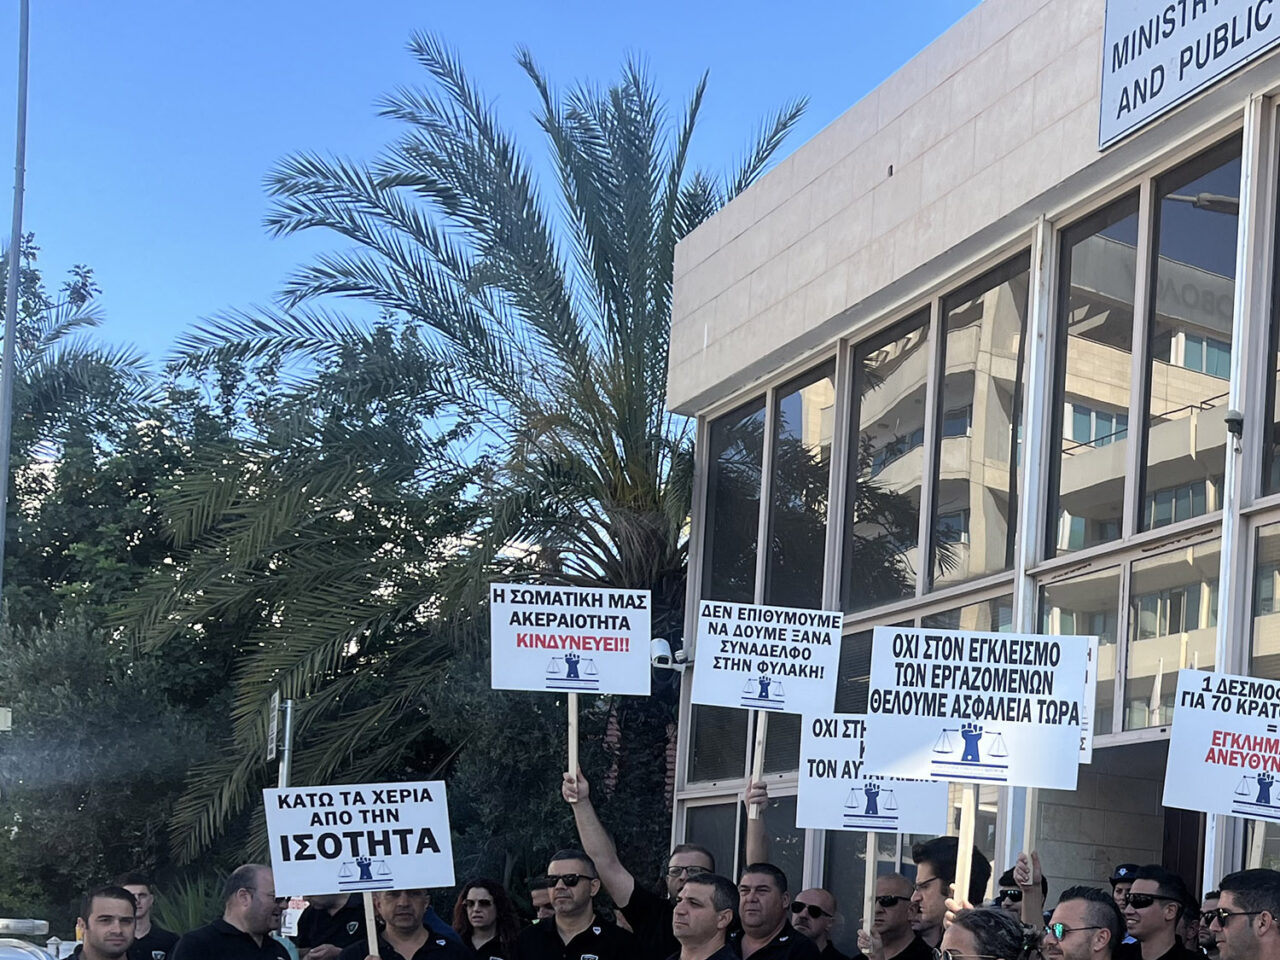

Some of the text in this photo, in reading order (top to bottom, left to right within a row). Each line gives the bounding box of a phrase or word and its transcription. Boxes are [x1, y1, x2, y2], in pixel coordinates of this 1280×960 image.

[1112, 0, 1219, 73] MINISTR
[1117, 0, 1273, 119] AND PUBLIC
[493, 589, 647, 610] Η ΣΩΜΑΤΙΚΗ ΜΑΣ
[510, 612, 631, 631] ΑΚΕΡΑΙΟΤΗΤΑ
[702, 604, 841, 629] ΔΕΝ ΕΠΙΘΥΜΟΥΜΕ
[516, 633, 630, 652] ΚΙΝΔΥΝΕΥΕΙ!!
[708, 622, 832, 645] ΝΑ ΔΟΥΜΕ ΞΑΝΑ
[720, 640, 812, 661] ΣΥΝΑΔΕΛΦΟ
[893, 634, 919, 659] ΟΧΙ
[923, 636, 964, 661] ΣΤΟΝ
[969, 637, 1061, 667] ΕΓΚΛΕΙΣΜΟ
[713, 657, 825, 680] ΣΤΗΝ ΦΥΛΑΚΗ!
[895, 663, 927, 688] ΤΩΝ
[931, 665, 1054, 695] ΕΡΓΑΖΟΜΕΝΩΝ
[1202, 676, 1213, 692] 1
[870, 689, 1080, 726] ΘΕΛΟΥΜΕ ΑΣΦΑΛΕΙΑ ΤΩΡΑ
[1181, 691, 1206, 709] ΓΙΑ
[1212, 695, 1232, 713] 70
[813, 719, 838, 738] ΟΧΙ
[807, 759, 837, 778] ΤΟΝ
[278, 788, 433, 809] ΚΑΤΩ ΤΑ ΧΕΡΙΑ
[310, 808, 399, 827] ΑΠΟ ΤΗΝ
[280, 828, 441, 862] ΙΣΟΤΗΤΑ
